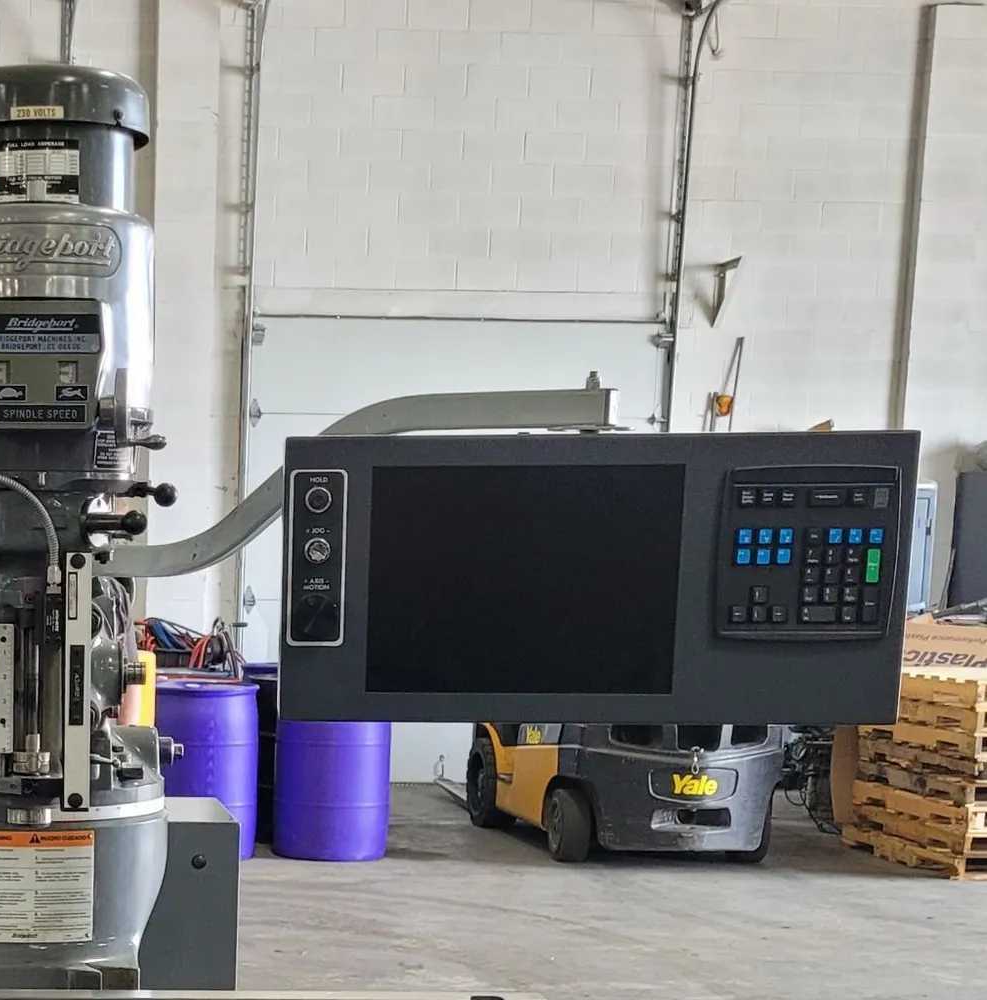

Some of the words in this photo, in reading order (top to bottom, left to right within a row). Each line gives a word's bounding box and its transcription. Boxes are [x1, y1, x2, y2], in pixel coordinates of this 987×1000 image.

[16, 108, 31, 118] 230
[33, 108, 57, 117] VOLTS
[6, 317, 76, 334] Bridgeport
[3, 409, 43, 419] SPINDLE
[47, 409, 78, 420] SPEED
[311, 527, 326, 535] JOG
[672, 773, 718, 796] Yale
